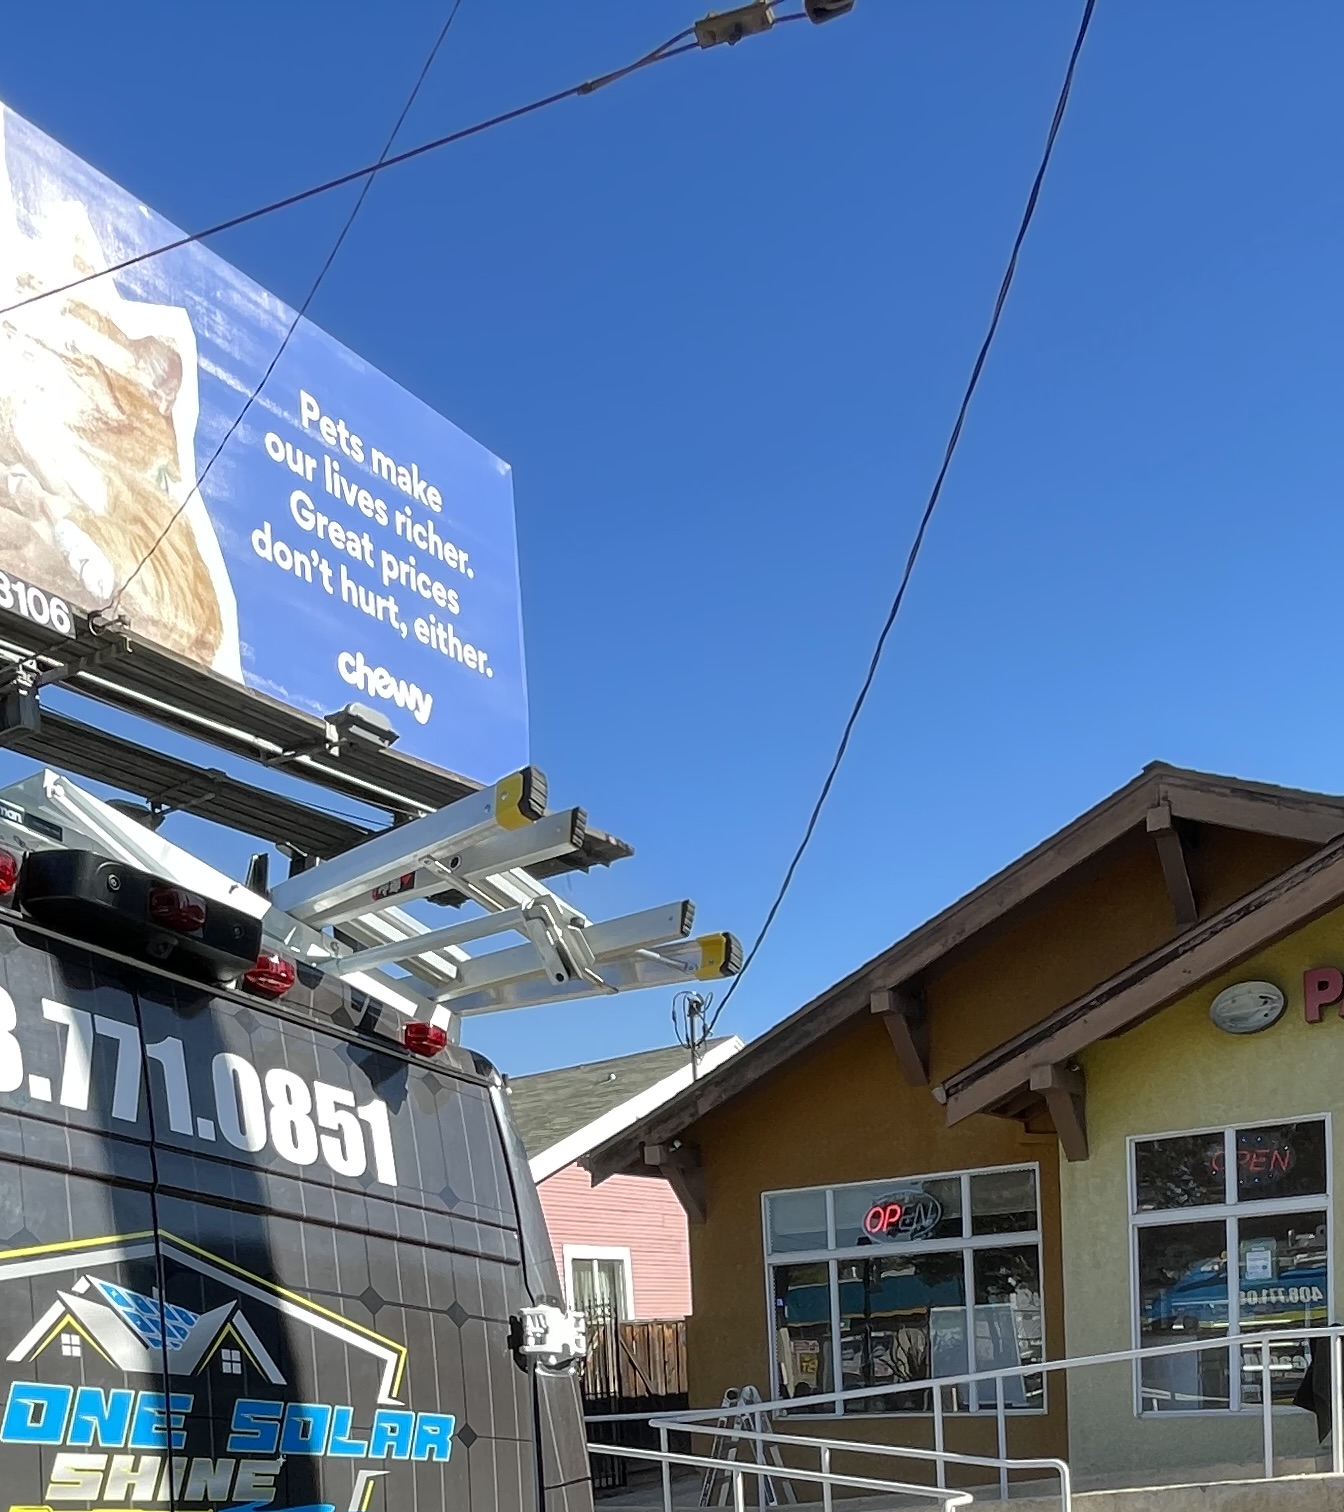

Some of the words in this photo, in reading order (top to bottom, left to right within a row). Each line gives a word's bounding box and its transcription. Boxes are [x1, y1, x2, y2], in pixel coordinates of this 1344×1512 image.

[300, 389, 364, 463] Pets
[371, 447, 443, 513] make
[265, 432, 317, 482] our
[324, 454, 388, 526] lives
[395, 506, 475, 579] richer.
[290, 490, 374, 568] Great
[381, 550, 460, 615] prices
[251, 521, 333, 594] don't
[340, 564, 408, 639] hurt,
[414, 614, 493, 679] either.
[337, 651, 433, 725] chewy
[865, 1201, 934, 1233] OPEN
[44, 1450, 286, 1504] SHINE
[227, 1399, 457, 1464] SOLAR
